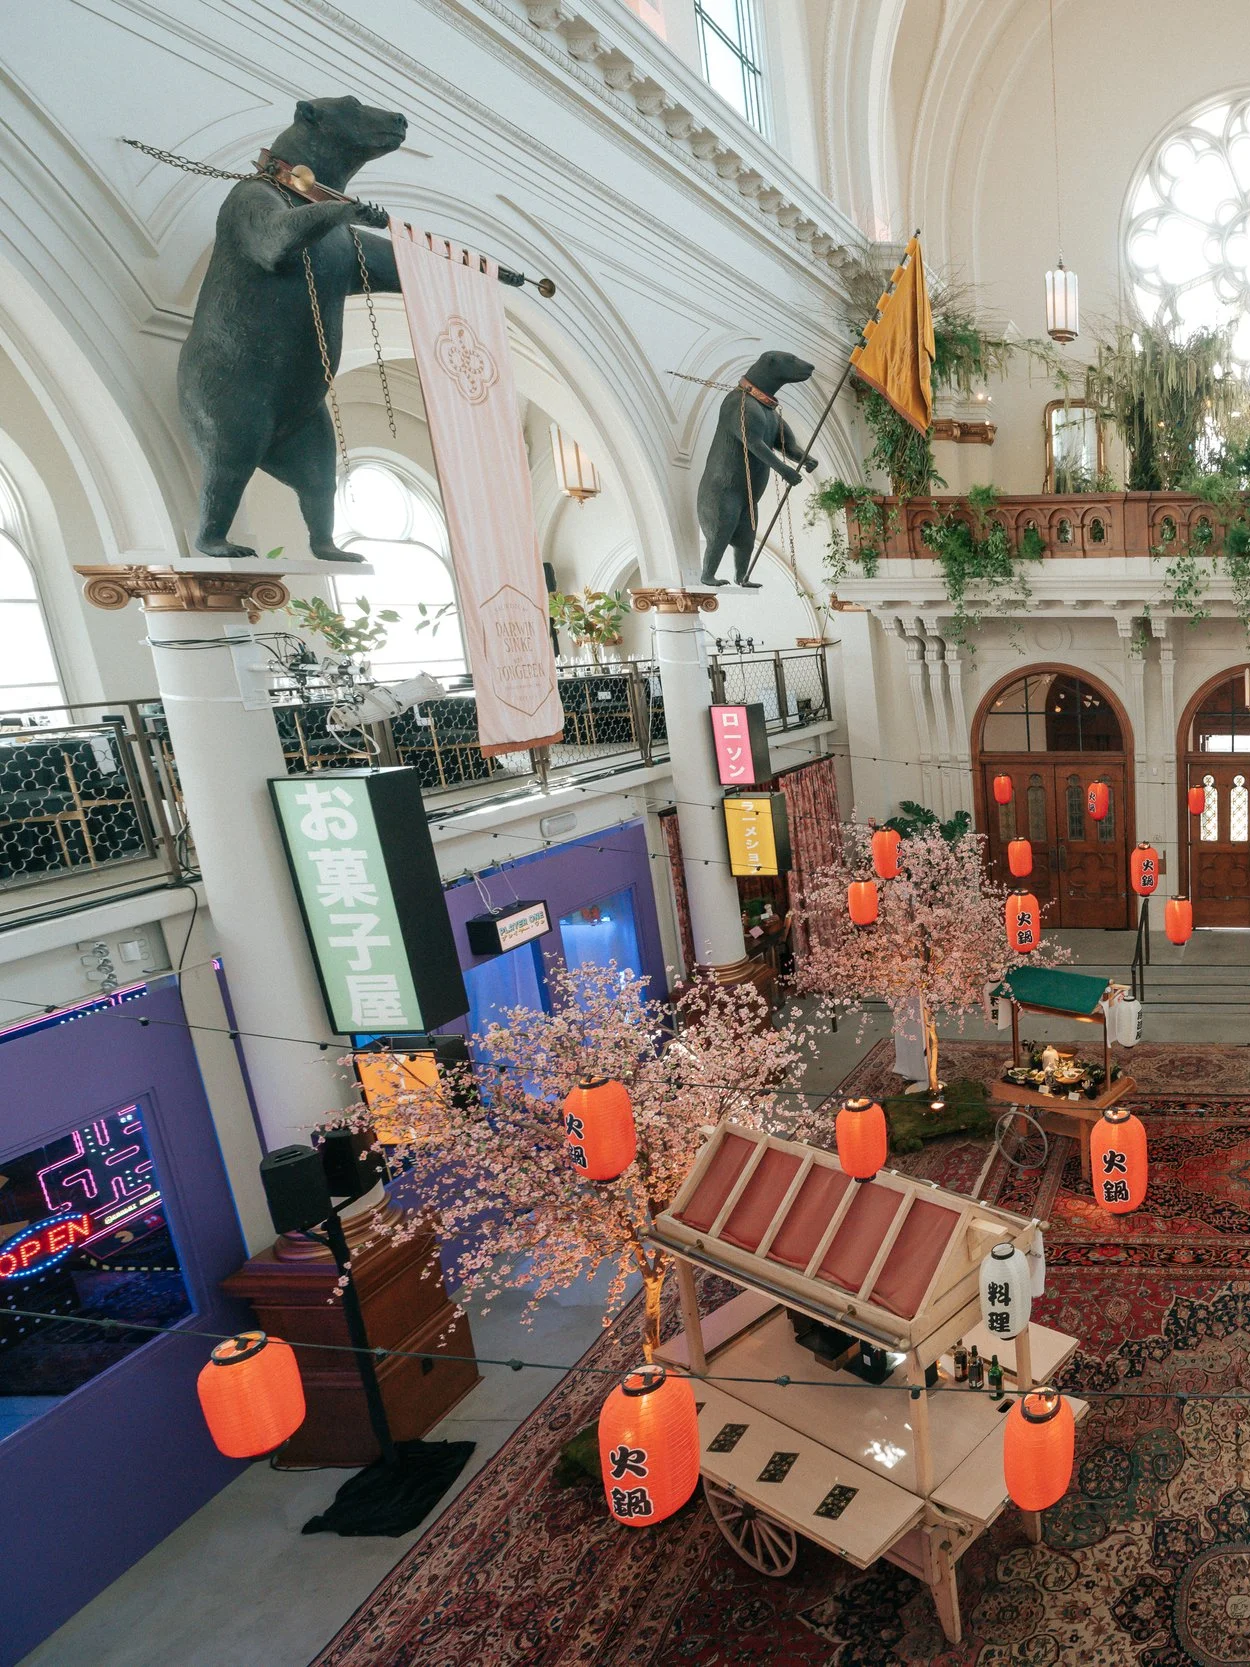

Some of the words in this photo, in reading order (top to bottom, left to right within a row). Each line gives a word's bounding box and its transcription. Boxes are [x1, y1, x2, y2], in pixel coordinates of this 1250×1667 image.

[495, 620, 536, 638] DARWIN
[722, 713, 745, 777] ローソン
[1142, 859, 1154, 887] 火鍋
[295, 783, 408, 1027] お菓子屋
[529, 910, 545, 923] ONE
[1017, 911, 1032, 944] 火鍋
[1103, 1150, 1129, 1202] 火鍋
[0, 1214, 89, 1278] OPEN
[988, 1282, 1011, 1332] 料理
[610, 1445, 653, 1517] 火鍋
